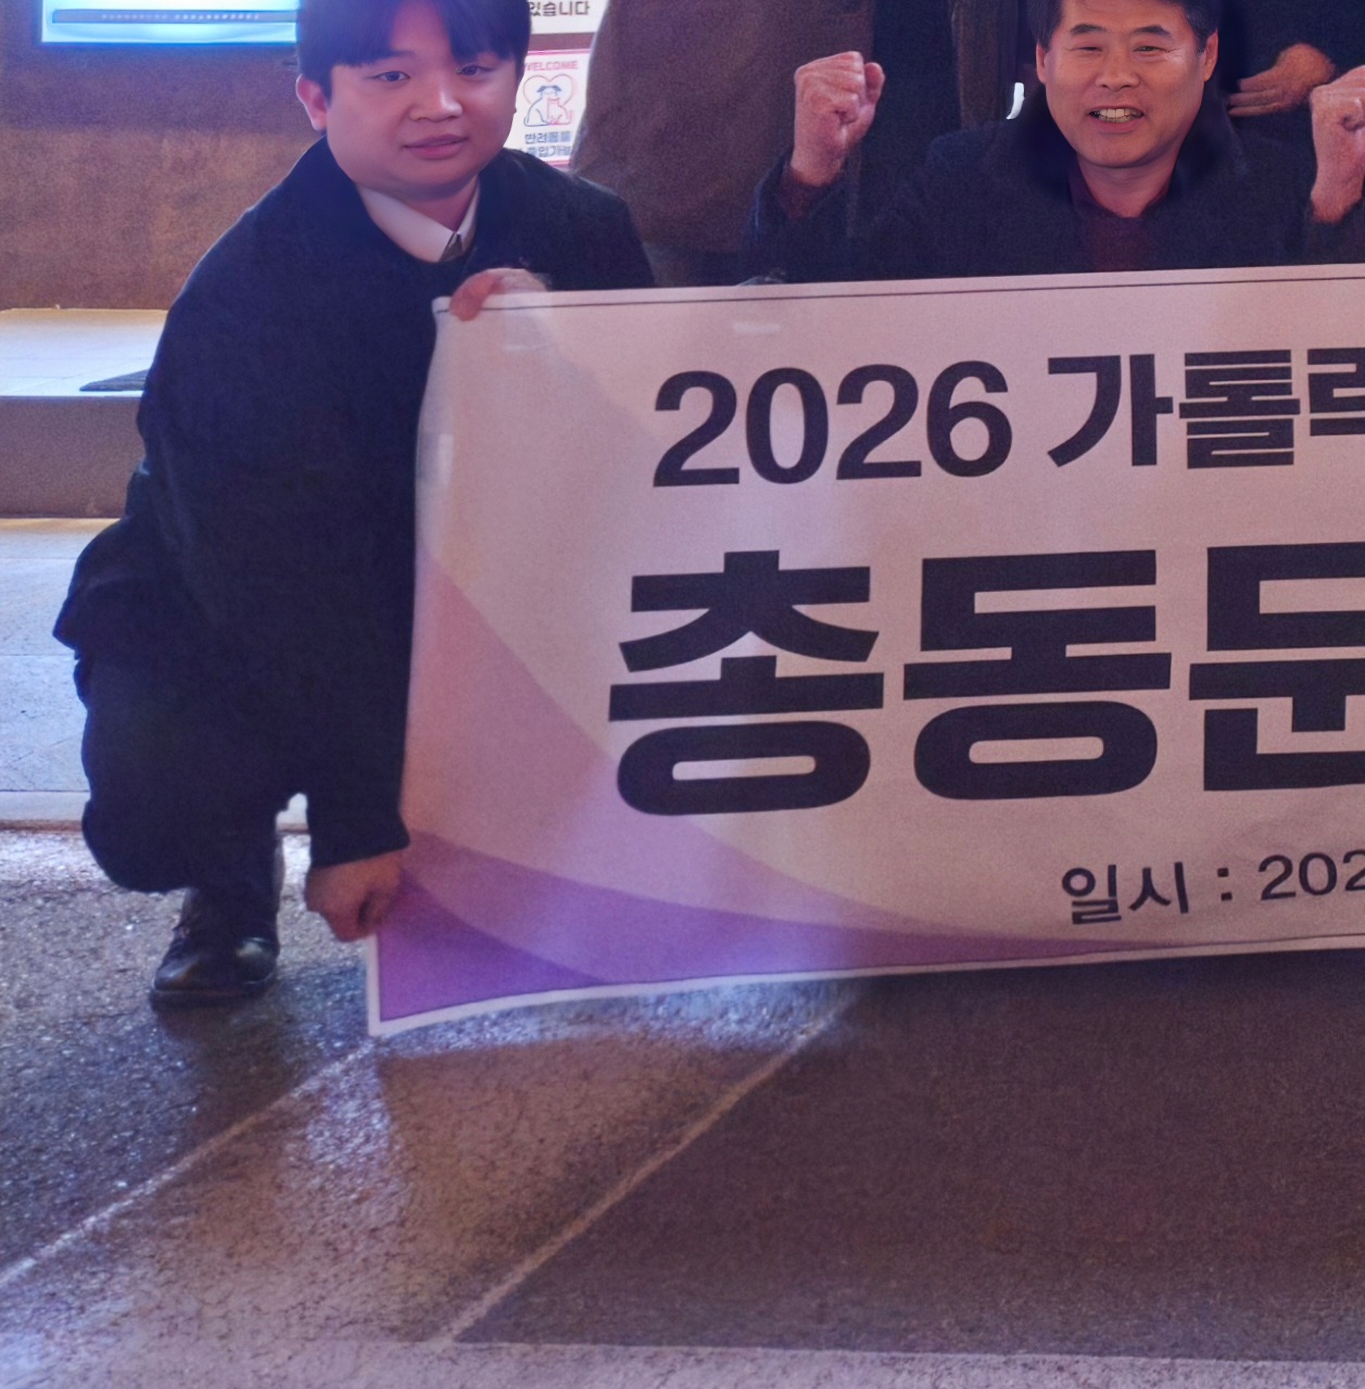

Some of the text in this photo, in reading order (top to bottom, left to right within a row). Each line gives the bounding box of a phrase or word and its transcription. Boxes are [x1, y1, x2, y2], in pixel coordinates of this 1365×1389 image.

[653, 360, 1013, 488] 2026
[1060, 861, 1190, 925] 일시
[1217, 867, 1230, 903] :
